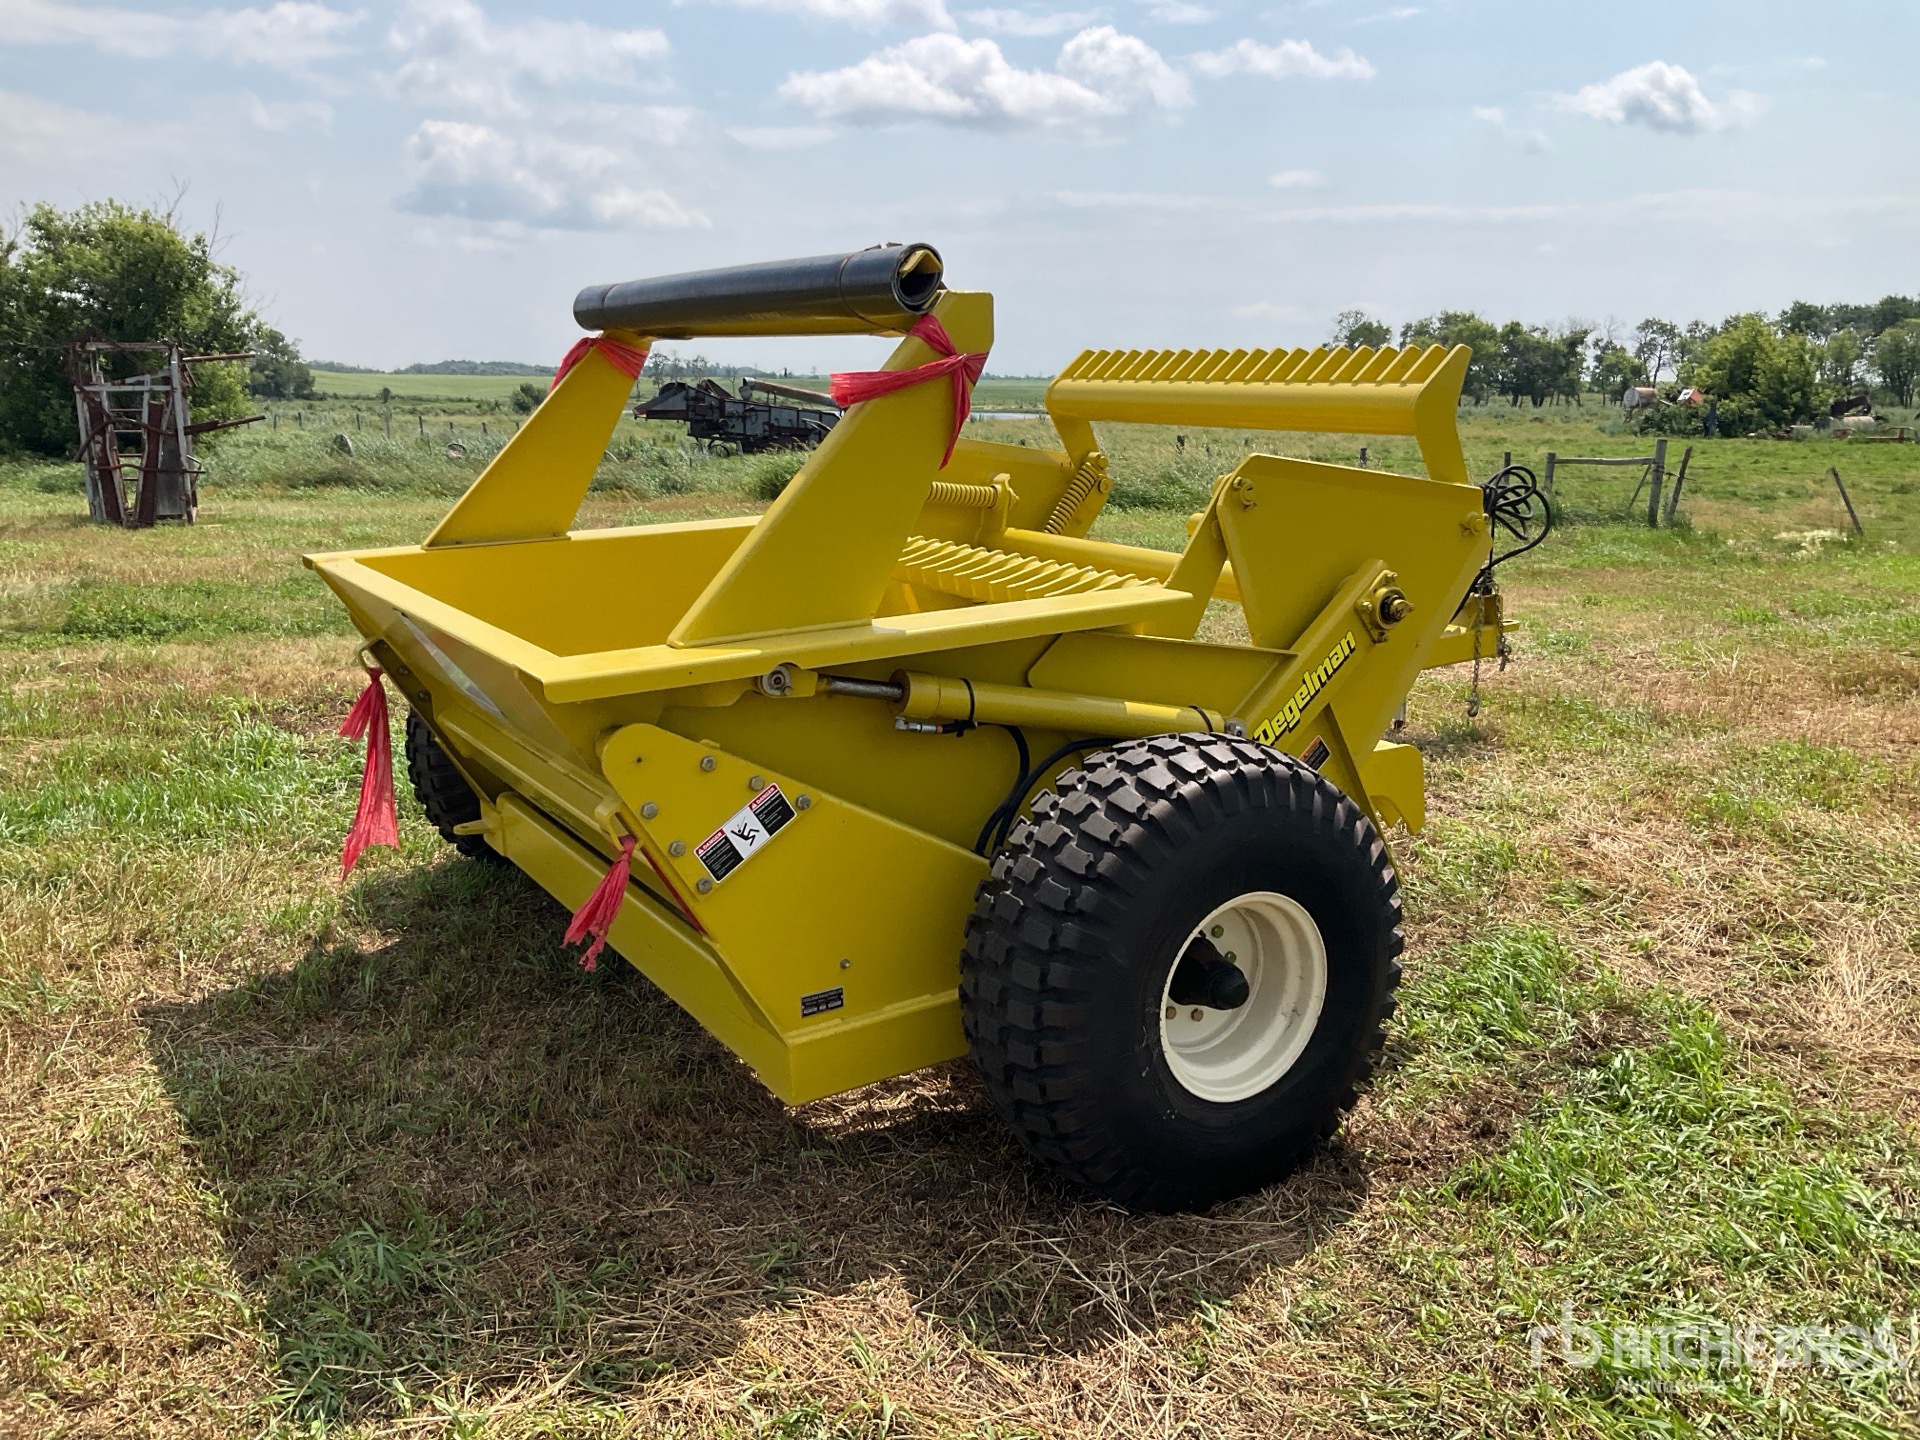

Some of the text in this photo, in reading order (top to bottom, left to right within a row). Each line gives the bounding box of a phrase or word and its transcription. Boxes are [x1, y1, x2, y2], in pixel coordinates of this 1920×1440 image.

[1253, 630, 1356, 746] Degelman
[755, 787, 775, 804] DANGER
[703, 831, 722, 850] DANGER
